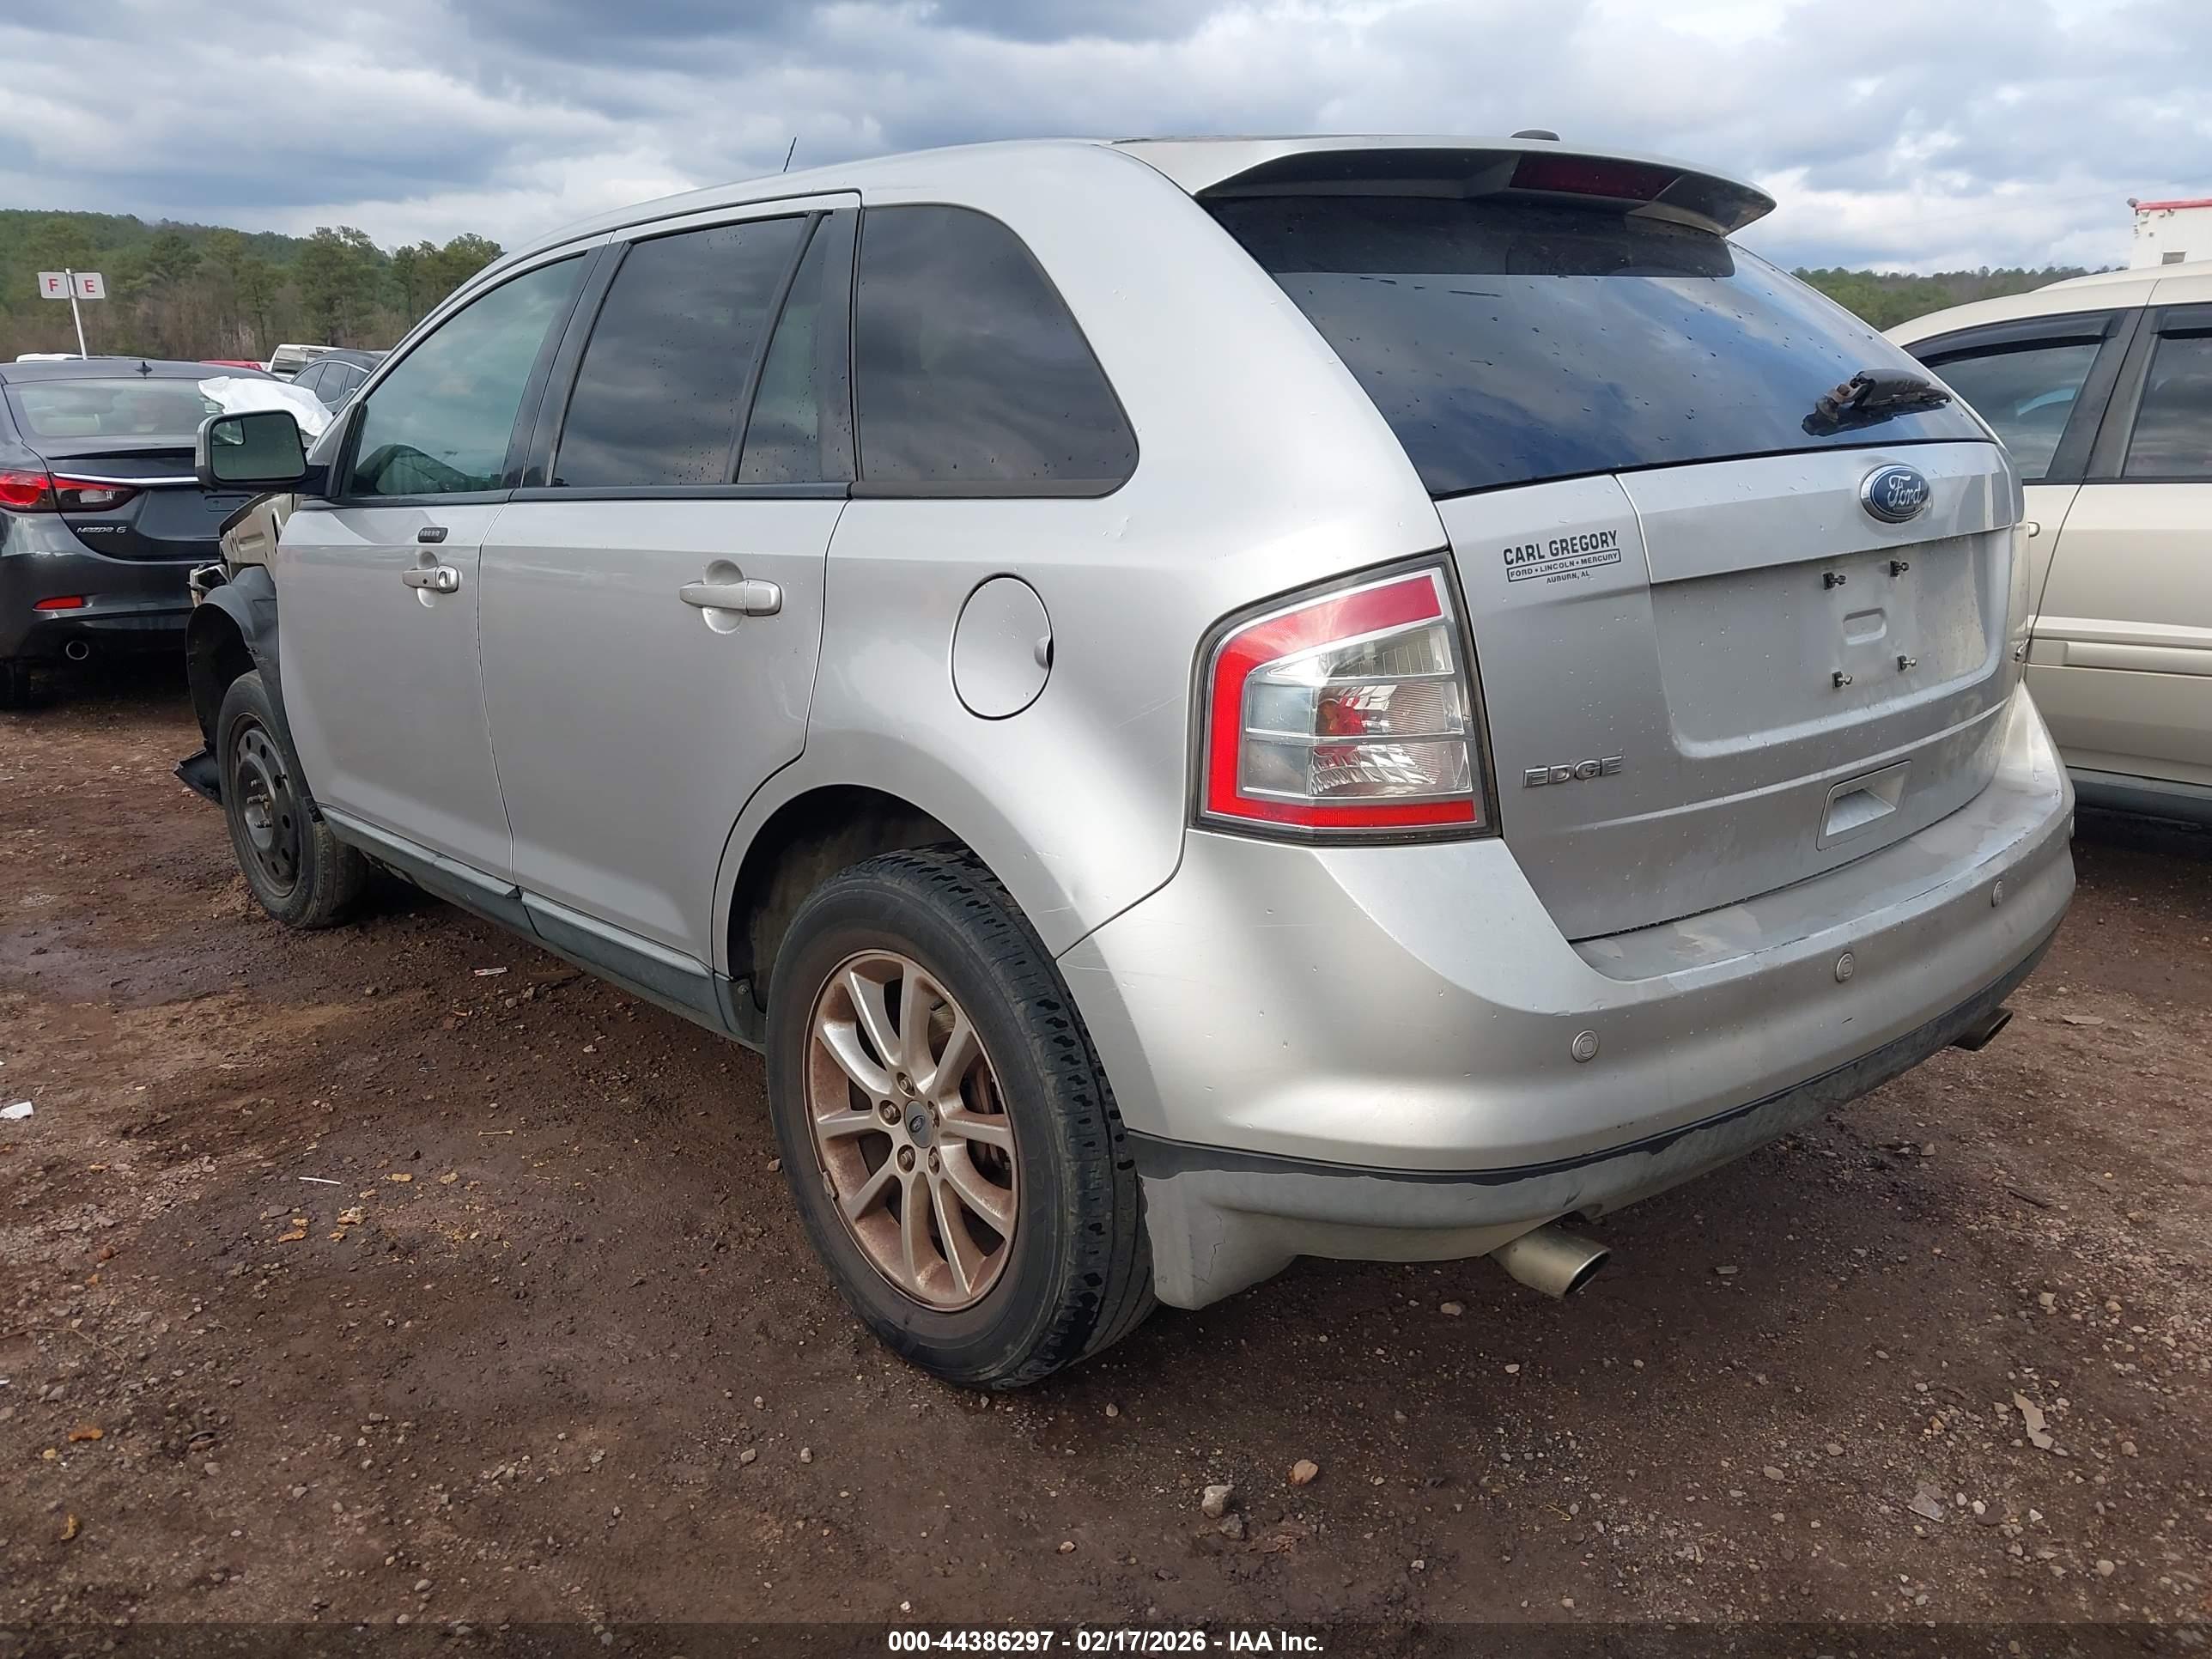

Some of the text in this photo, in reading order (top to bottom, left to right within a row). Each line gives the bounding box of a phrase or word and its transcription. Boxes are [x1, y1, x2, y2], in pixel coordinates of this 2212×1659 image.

[48, 278, 58, 292] F
[84, 279, 96, 293] E
[1887, 474, 1923, 507] Ford
[116, 526, 127, 534] 6
[1504, 530, 1617, 565] CARL GREGORY
[1510, 552, 1618, 578] FORD LINCOLN MERCURY
[1547, 569, 1590, 584] AUBURN, AL
[1523, 756, 1622, 788] EDGE
